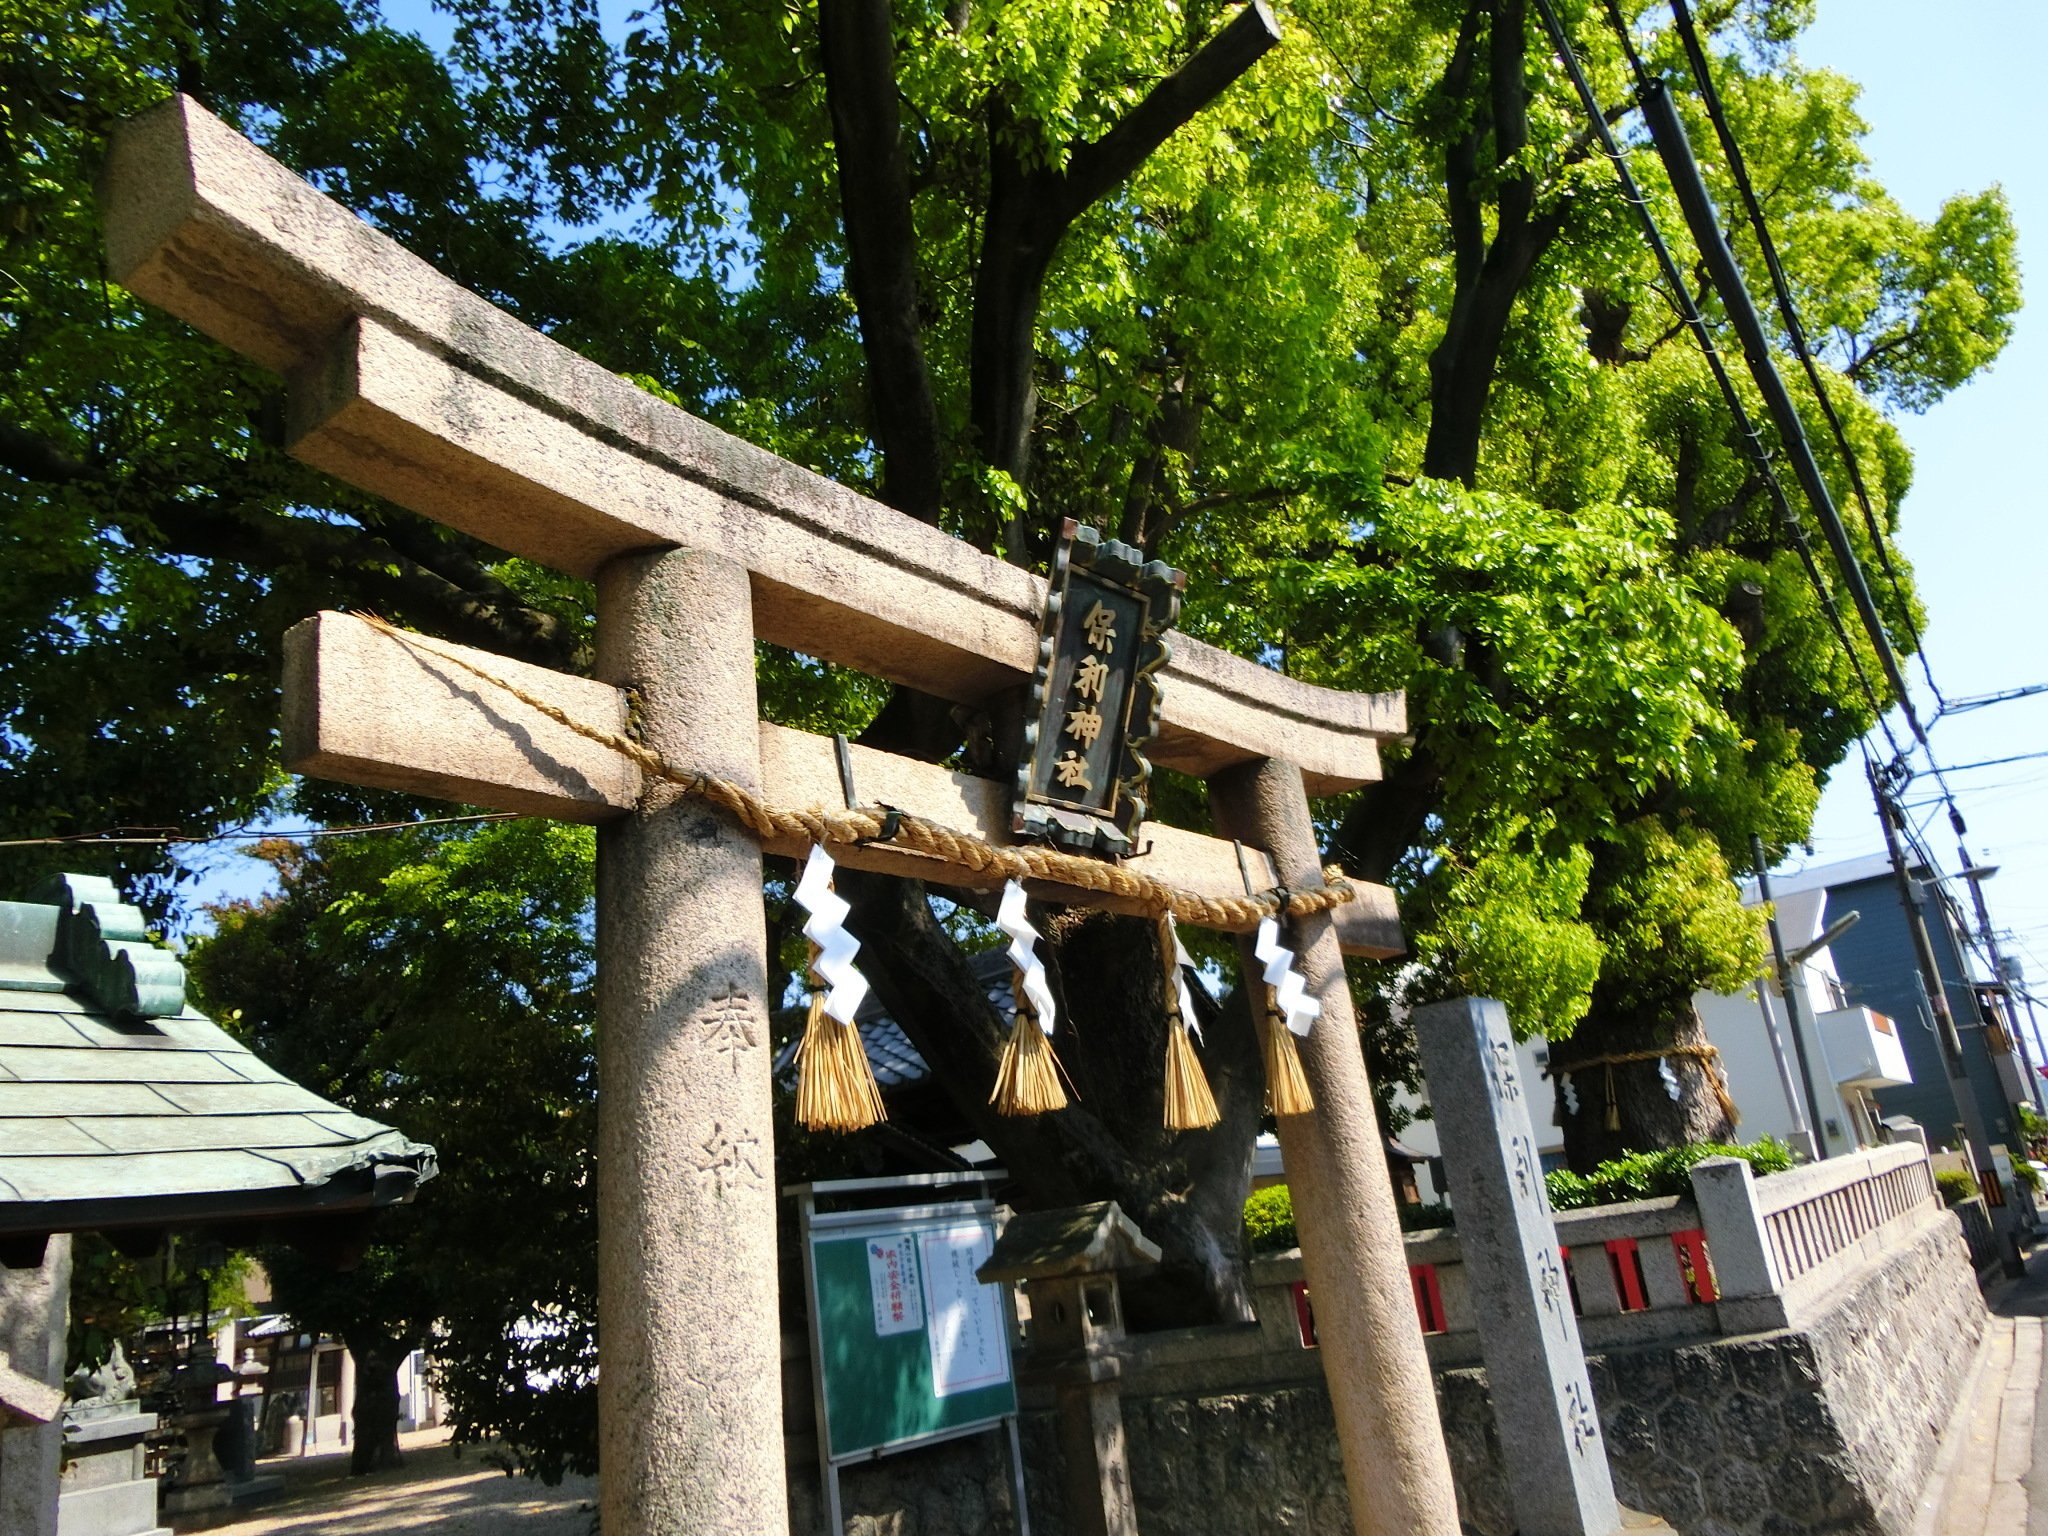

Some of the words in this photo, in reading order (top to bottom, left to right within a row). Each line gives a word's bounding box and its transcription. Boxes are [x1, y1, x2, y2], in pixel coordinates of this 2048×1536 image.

[1054, 599, 1117, 792] 保利神社
[692, 981, 765, 1198] 奉納
[1489, 1037, 1596, 1457] 保利神社
